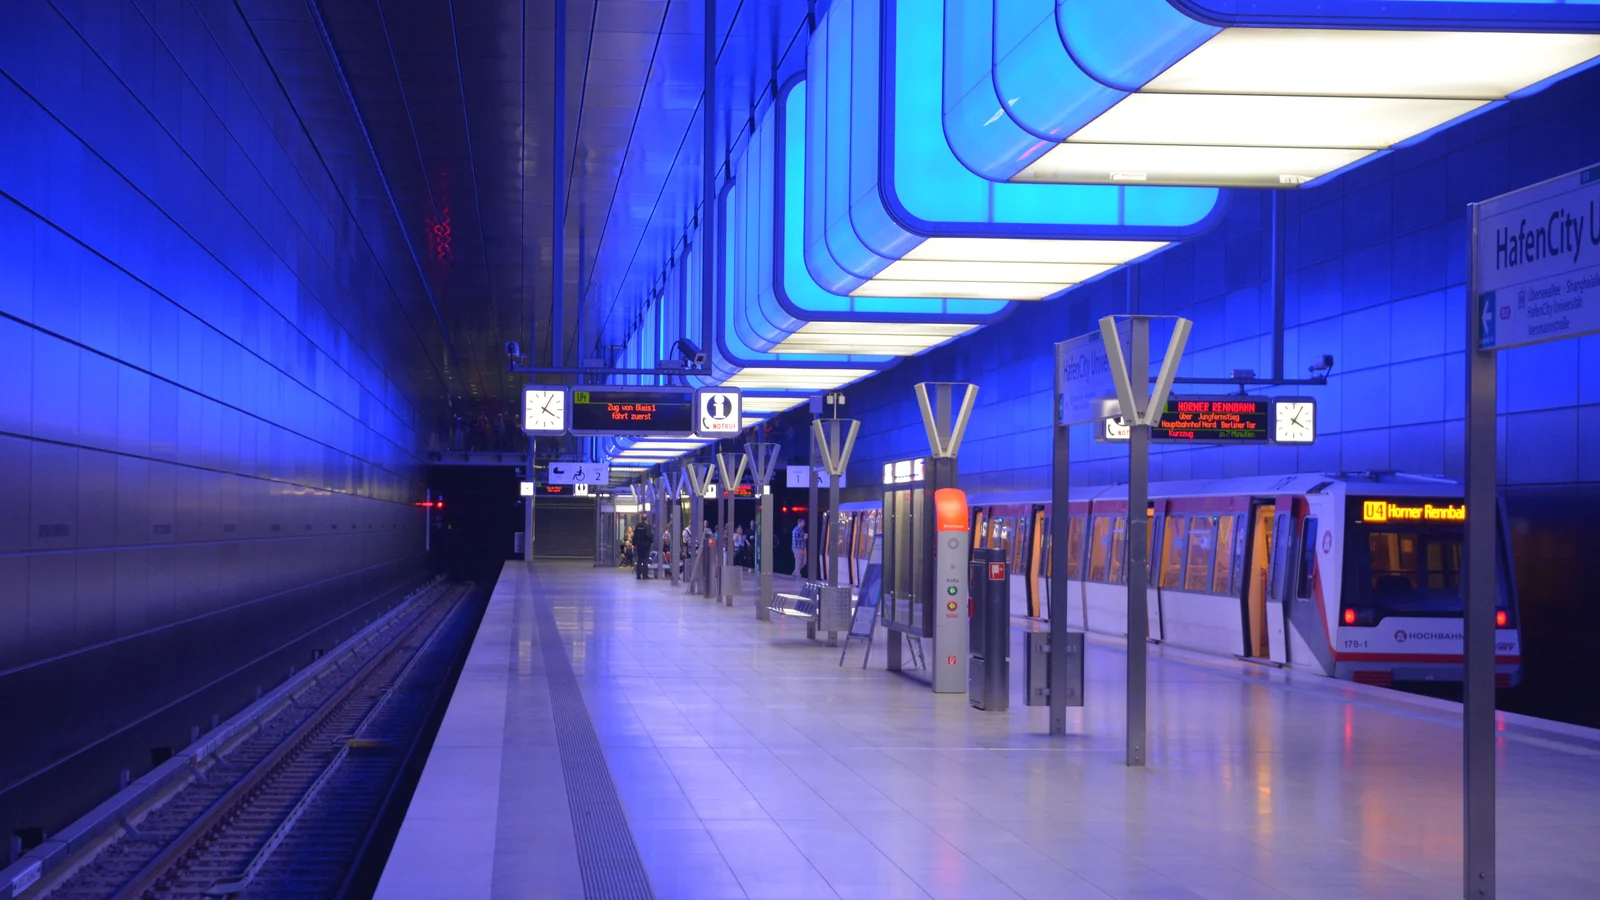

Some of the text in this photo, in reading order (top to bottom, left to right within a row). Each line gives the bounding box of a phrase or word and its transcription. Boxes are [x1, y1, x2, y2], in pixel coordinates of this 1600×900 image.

[1496, 208, 1584, 270] HafenCity
[1064, 354, 1089, 382] HafenCity
[607, 403, 620, 413] Zug
[1177, 401, 1256, 413] HORNER RENNBAHN
[631, 412, 652, 420] zuerst
[1179, 412, 1240, 423] über Jungfernstieg
[1221, 420, 1246, 429] Berliner
[1246, 420, 1257, 428] Tor
[1168, 429, 1194, 438] Kurzzug
[595, 472, 601, 481] 2
[796, 474, 800, 483] 1
[1366, 504, 1384, 518] U4
[1388, 504, 1424, 519] Horner
[1344, 640, 1368, 649] 178-1
